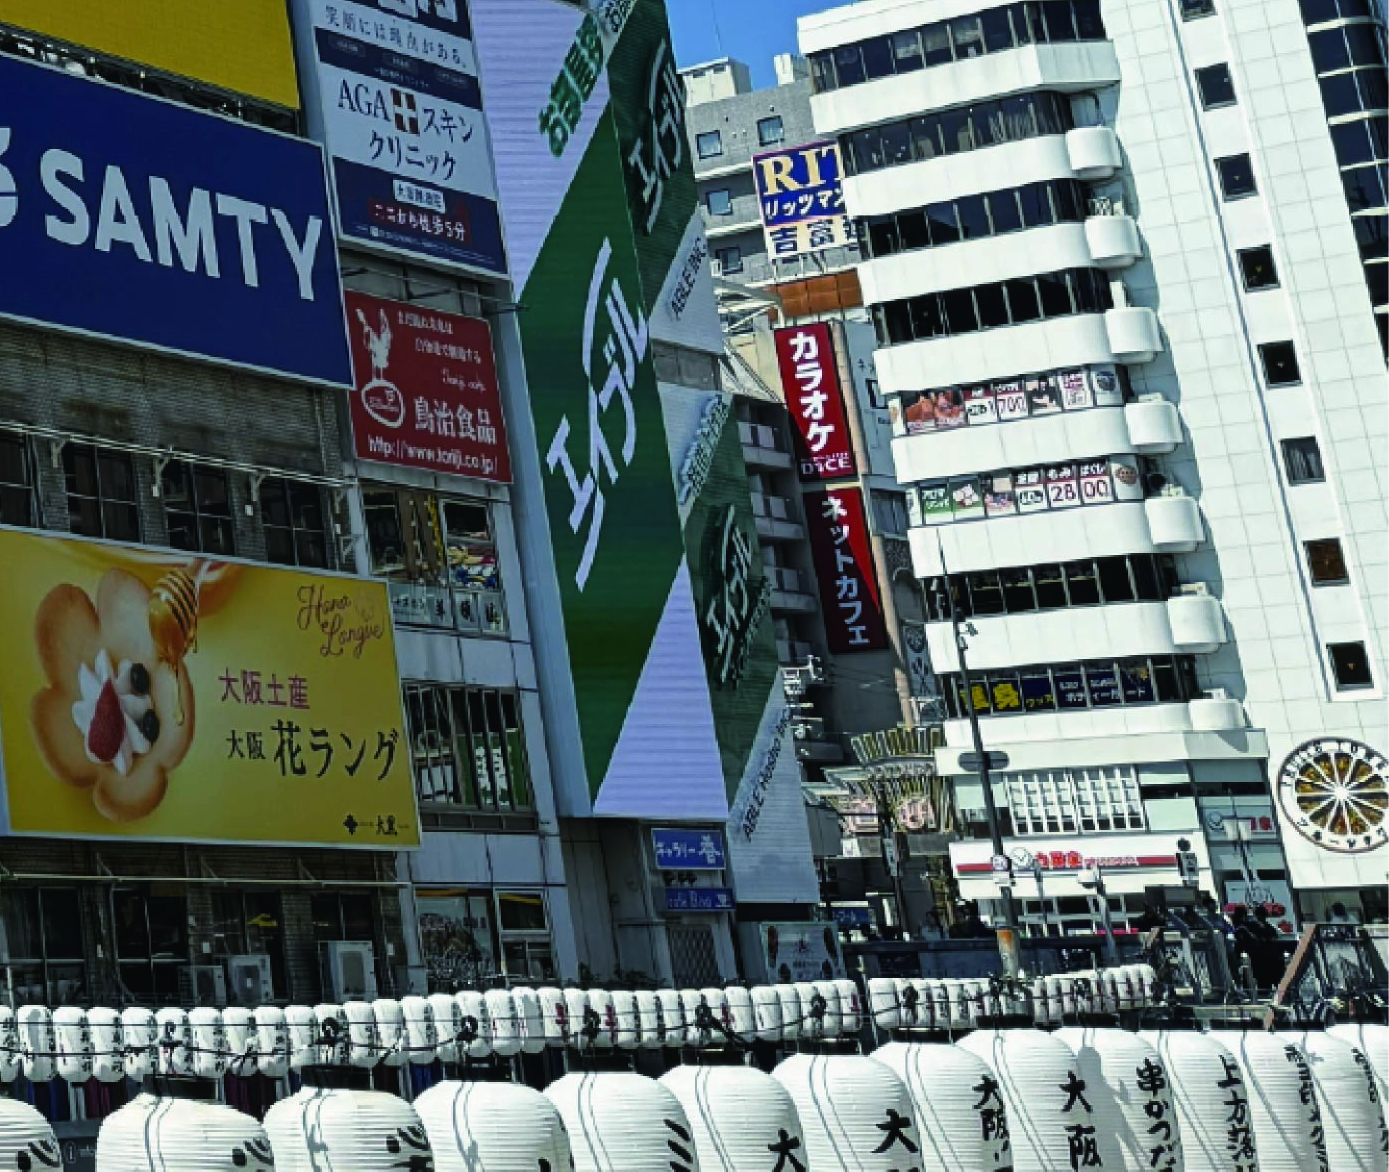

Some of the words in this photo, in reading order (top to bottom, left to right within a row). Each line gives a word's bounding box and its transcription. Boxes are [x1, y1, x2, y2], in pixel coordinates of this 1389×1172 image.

[338, 78, 391, 122] AGA
[423, 108, 474, 144] スキン
[369, 129, 456, 180] クリニック
[40, 148, 323, 302] SAMTY
[788, 331, 835, 453] カラオケ
[823, 496, 870, 646] ネットカフェ
[297, 584, 351, 630] Hana
[218, 669, 311, 710] 大阪土産
[226, 730, 267, 760] 大阪
[271, 719, 399, 782] 花ラング
[1137, 1057, 1176, 1172] 串かつだ
